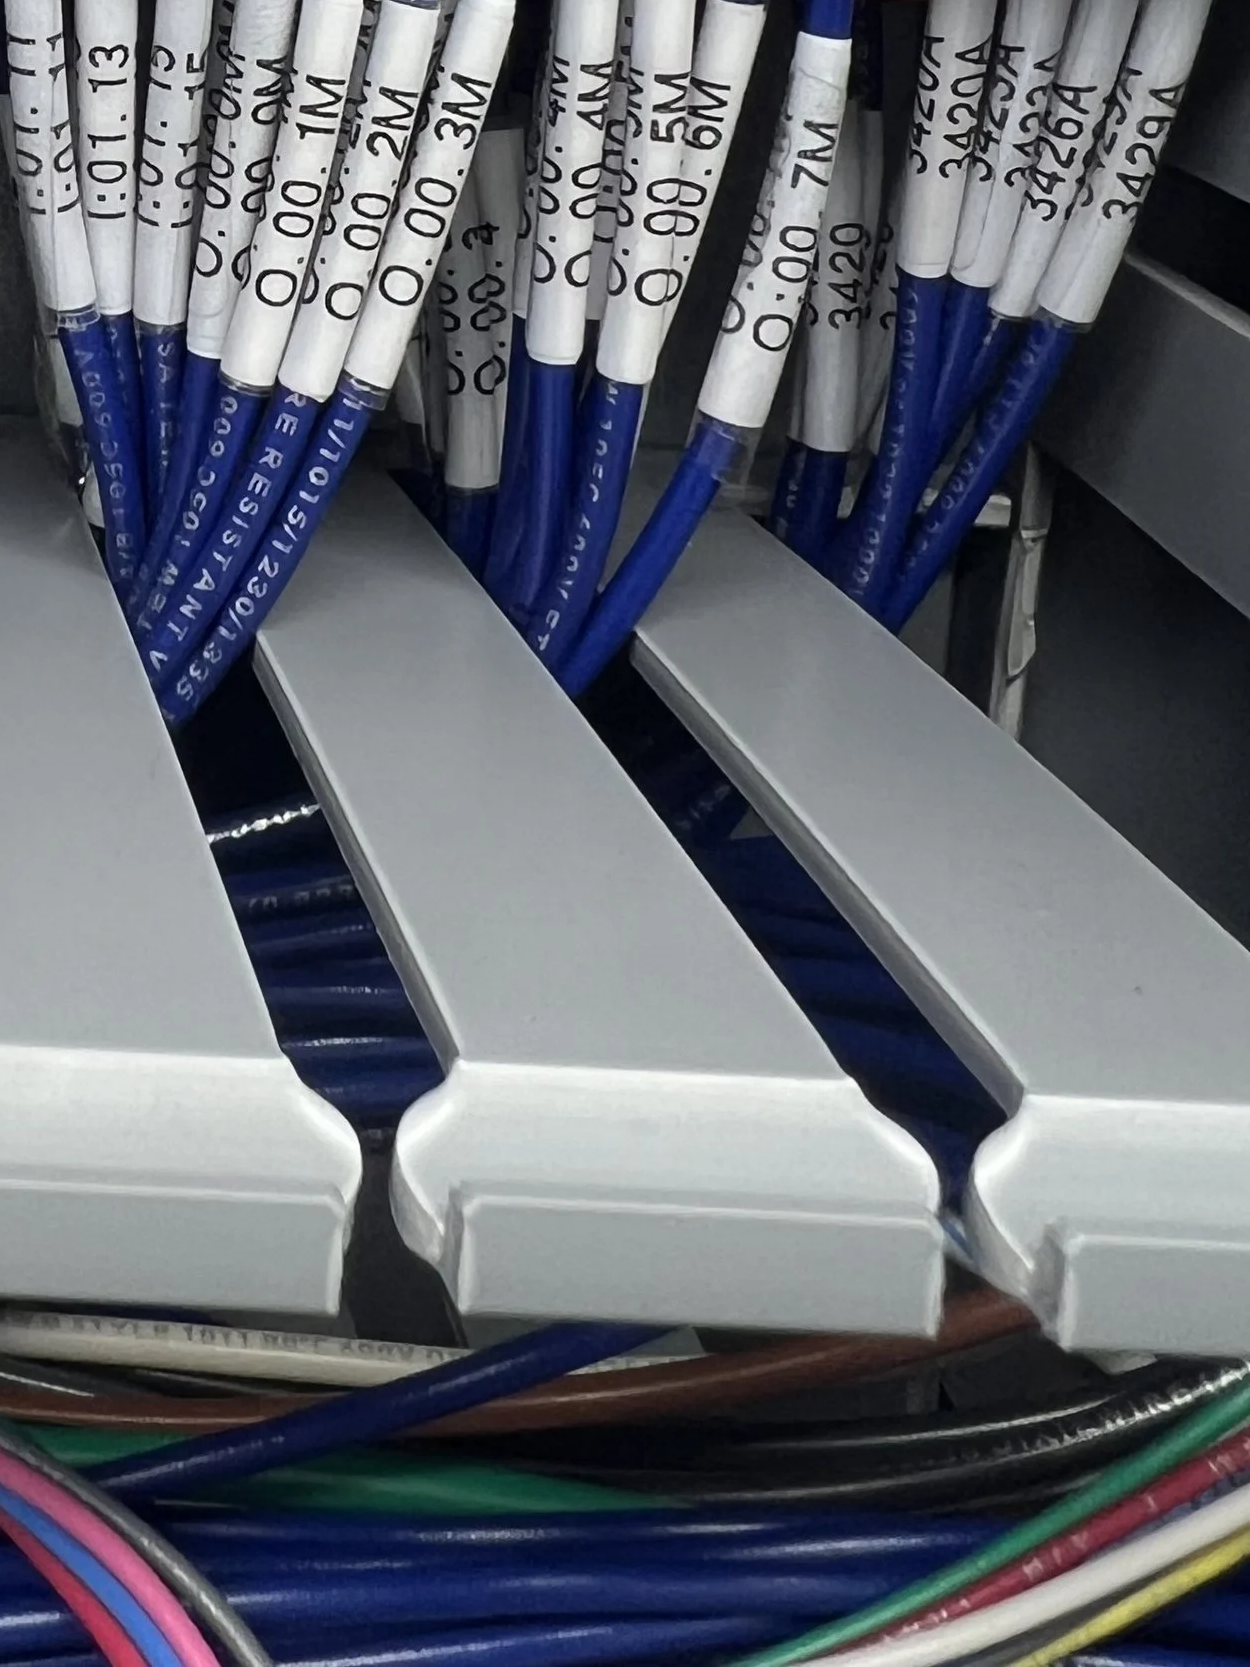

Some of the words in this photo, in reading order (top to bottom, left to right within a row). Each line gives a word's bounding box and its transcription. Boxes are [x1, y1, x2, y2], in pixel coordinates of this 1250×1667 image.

[86, 44, 129, 219] I:01.13
[1025, 82, 1098, 222] 3426A
[1102, 82, 1186, 219] 3429A
[827, 222, 865, 331] 3420
[166, 446, 283, 641] RESISTANT
